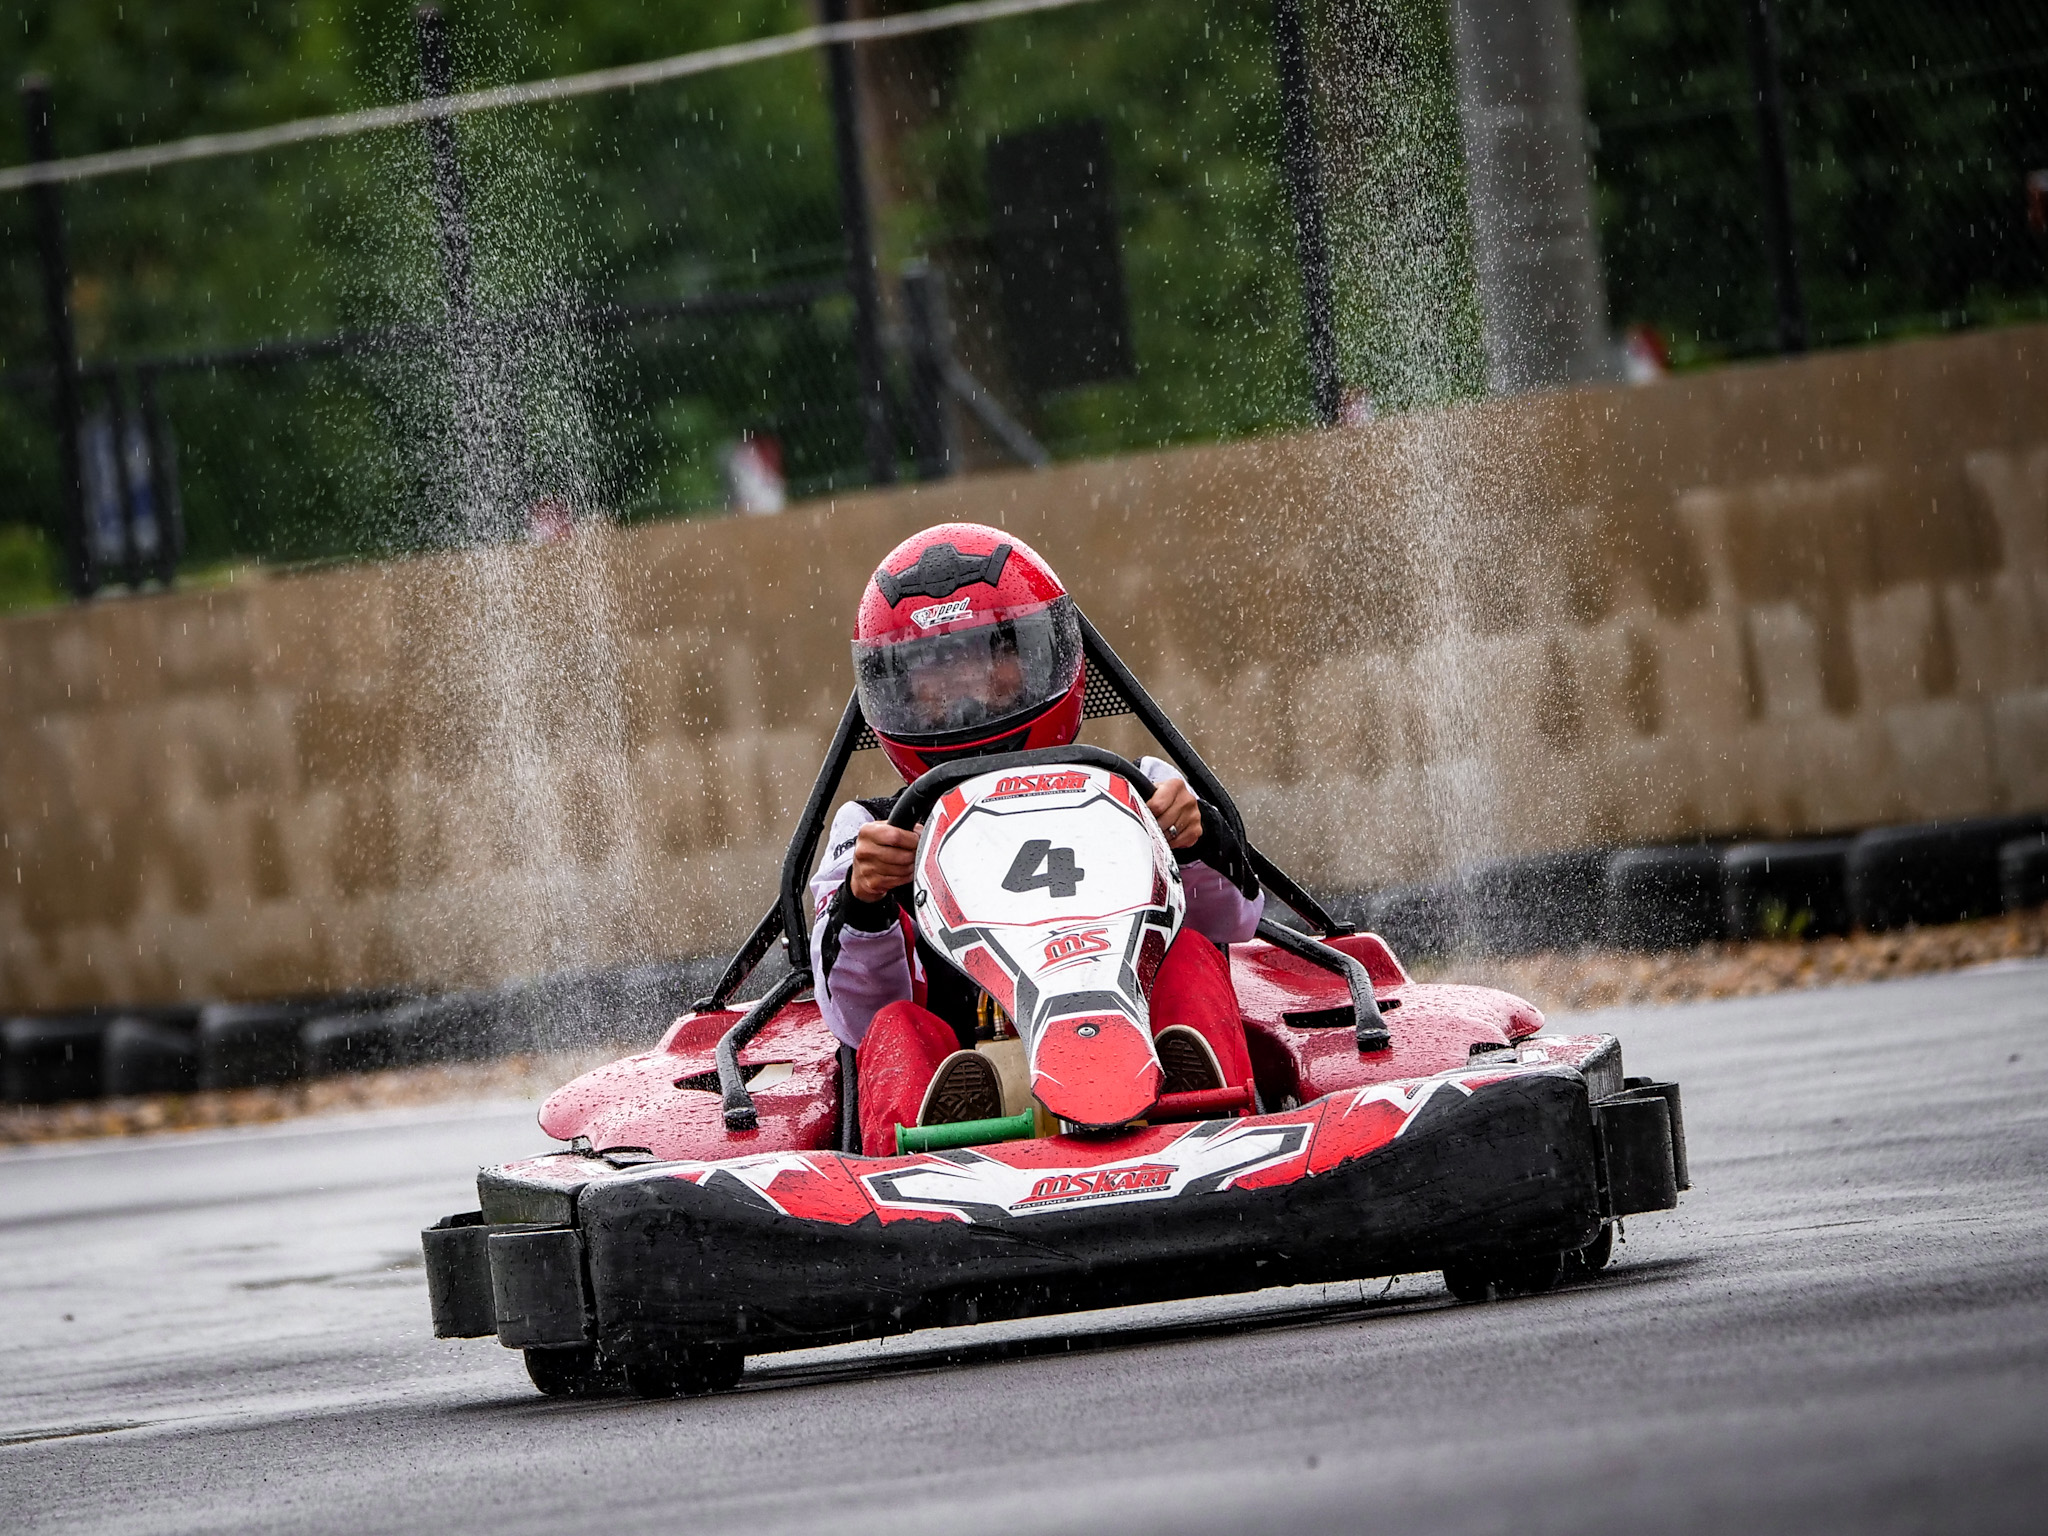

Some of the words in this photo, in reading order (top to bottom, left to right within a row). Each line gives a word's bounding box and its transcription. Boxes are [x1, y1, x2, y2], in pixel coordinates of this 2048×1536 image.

[1001, 839, 1085, 898] 4
[1037, 928, 1111, 972] MS
[1010, 1197, 1067, 1210] RACING
[1073, 1186, 1169, 1200] TECHNOLOGY
